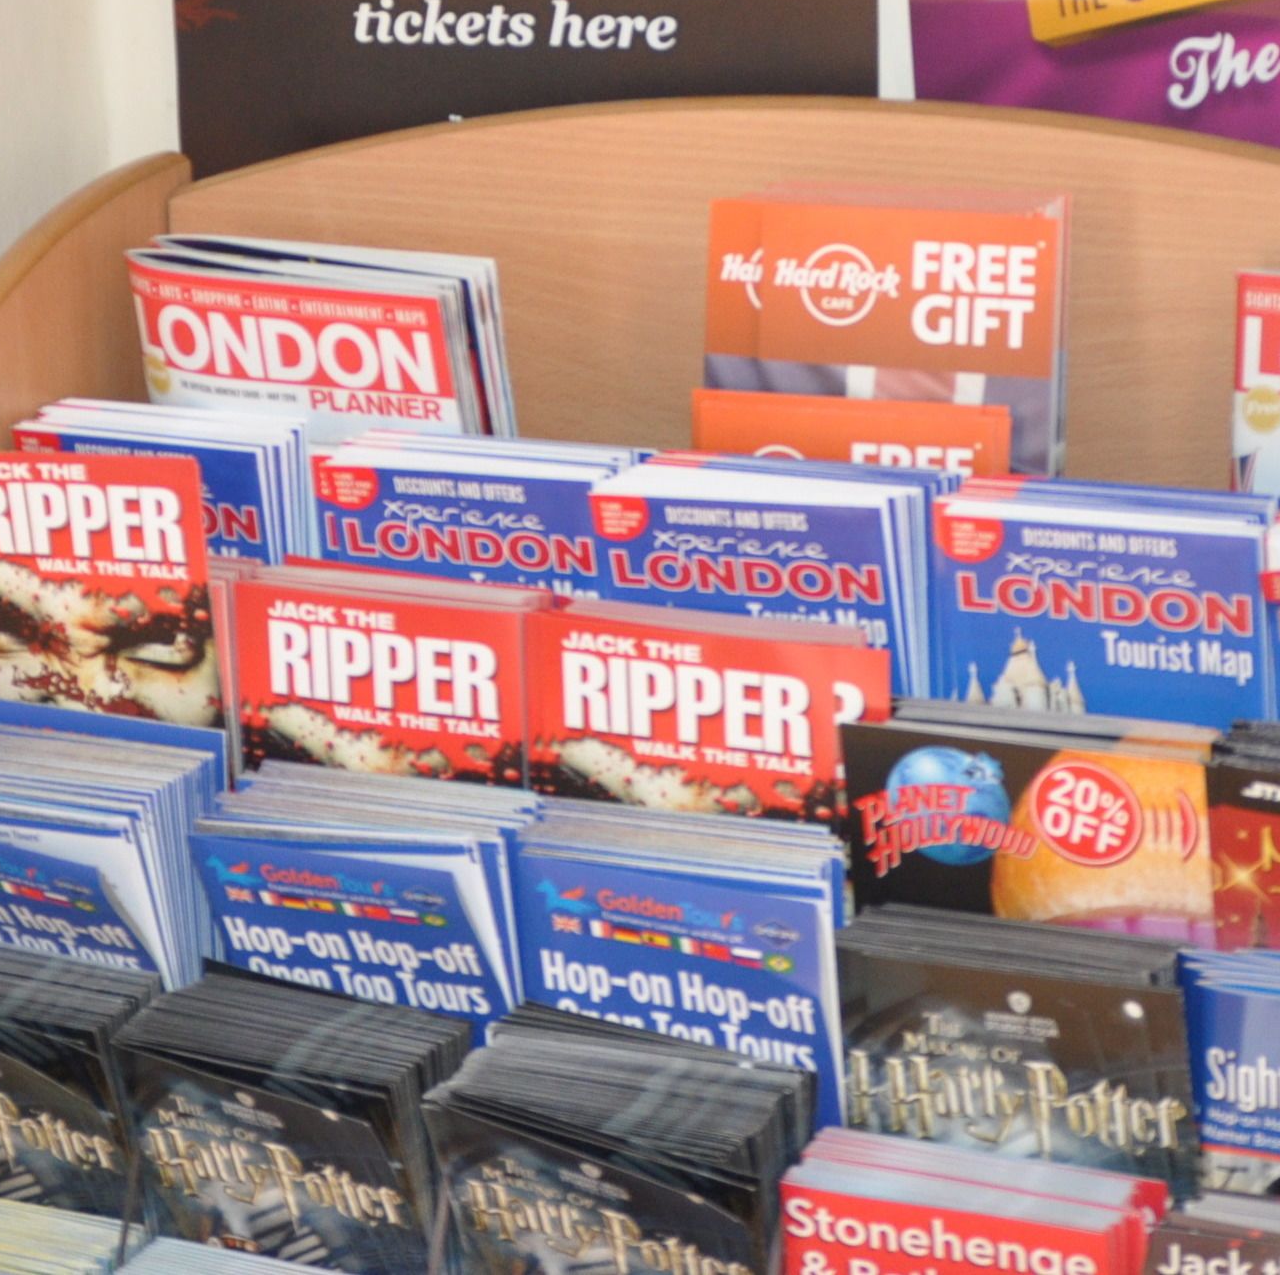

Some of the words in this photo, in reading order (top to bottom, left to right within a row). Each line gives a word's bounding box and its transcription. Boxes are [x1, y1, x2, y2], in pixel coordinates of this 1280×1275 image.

[774, 257, 835, 289] Hard
[839, 261, 901, 298] Rock
[912, 240, 1036, 295] FREE
[821, 296, 854, 311] CAFE
[911, 294, 1035, 349] GIFT
[134, 293, 439, 395] LONDON
[309, 388, 443, 421] PLANNER
[36, 463, 86, 482] THE
[37, 558, 91, 575] WALK
[95, 561, 133, 576] THE
[136, 564, 189, 580] TALK
[342, 517, 598, 577] LONDON
[1022, 527, 1095, 552] DISCOUNTS
[1098, 533, 1126, 554] AND
[1129, 536, 1177, 558] OFFERS
[608, 548, 885, 606] LONDON
[956, 571, 1254, 637] LONDON
[268, 600, 335, 625] JACK
[342, 607, 395, 632] THE
[268, 620, 499, 720] RIPPER
[561, 630, 636, 656] JACK
[643, 639, 702, 664] THE
[1100, 630, 1193, 673] Tourist
[1198, 640, 1254, 686] Map
[334, 704, 391, 727] WALK
[396, 712, 439, 733] THE
[442, 717, 500, 740] TALK
[561, 650, 811, 758] RIPPER
[633, 738, 697, 762] WALK
[702, 746, 746, 768] THE
[750, 752, 813, 776] TALK
[853, 783, 976, 845] PLANET
[1049, 770, 1130, 828] 20%
[868, 813, 1041, 878] HOLLYWOOD
[1043, 805, 1126, 853] OFF
[11, 904, 136, 950] Hop-off
[223, 915, 350, 961] Hop-on
[349, 929, 481, 976] Hop-off
[332, 964, 398, 1005] Top
[395, 971, 491, 1015] Tours
[540, 949, 675, 1008] Hop-on
[677, 971, 816, 1035] Hop-off
[719, 1023, 817, 1072] Tours
[885, 1054, 1024, 1144] Harry
[1023, 1061, 1189, 1160] Potter
[145, 1127, 270, 1205] Harry
[262, 1142, 409, 1232] Potter
[465, 1179, 601, 1257] Harry
